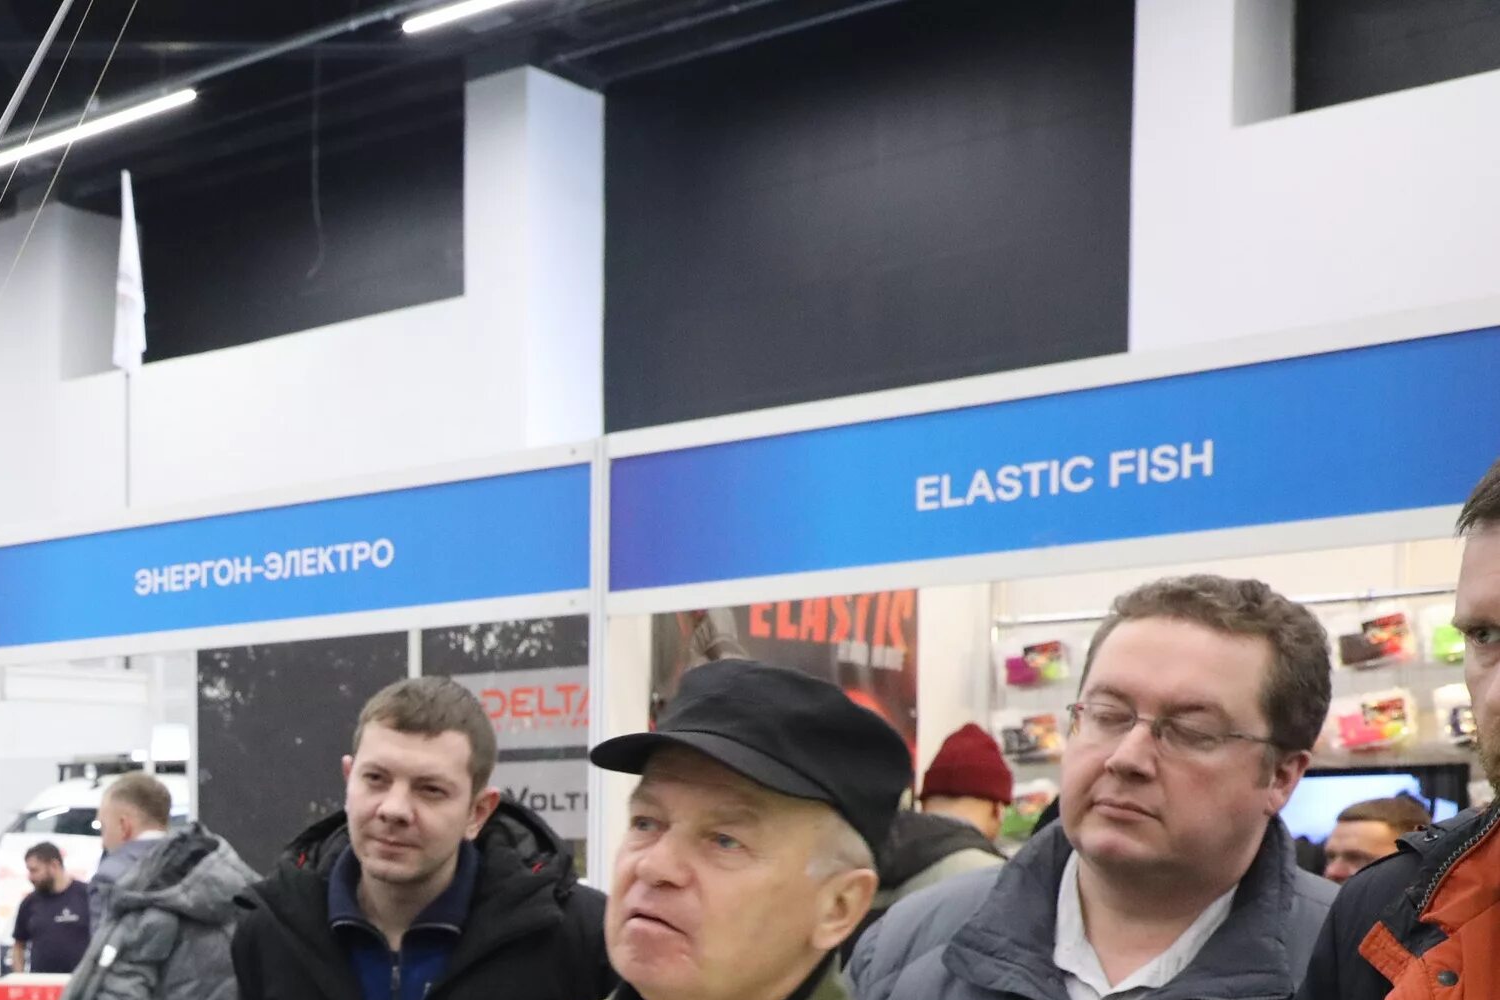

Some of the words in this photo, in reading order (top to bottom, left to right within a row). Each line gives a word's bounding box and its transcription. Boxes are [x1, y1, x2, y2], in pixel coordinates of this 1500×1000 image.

[915, 454, 1094, 511] ELASTIC
[1108, 439, 1213, 488] FISH
[133, 538, 395, 596] ЭНЕРГОН-ЭЛЕКТРО
